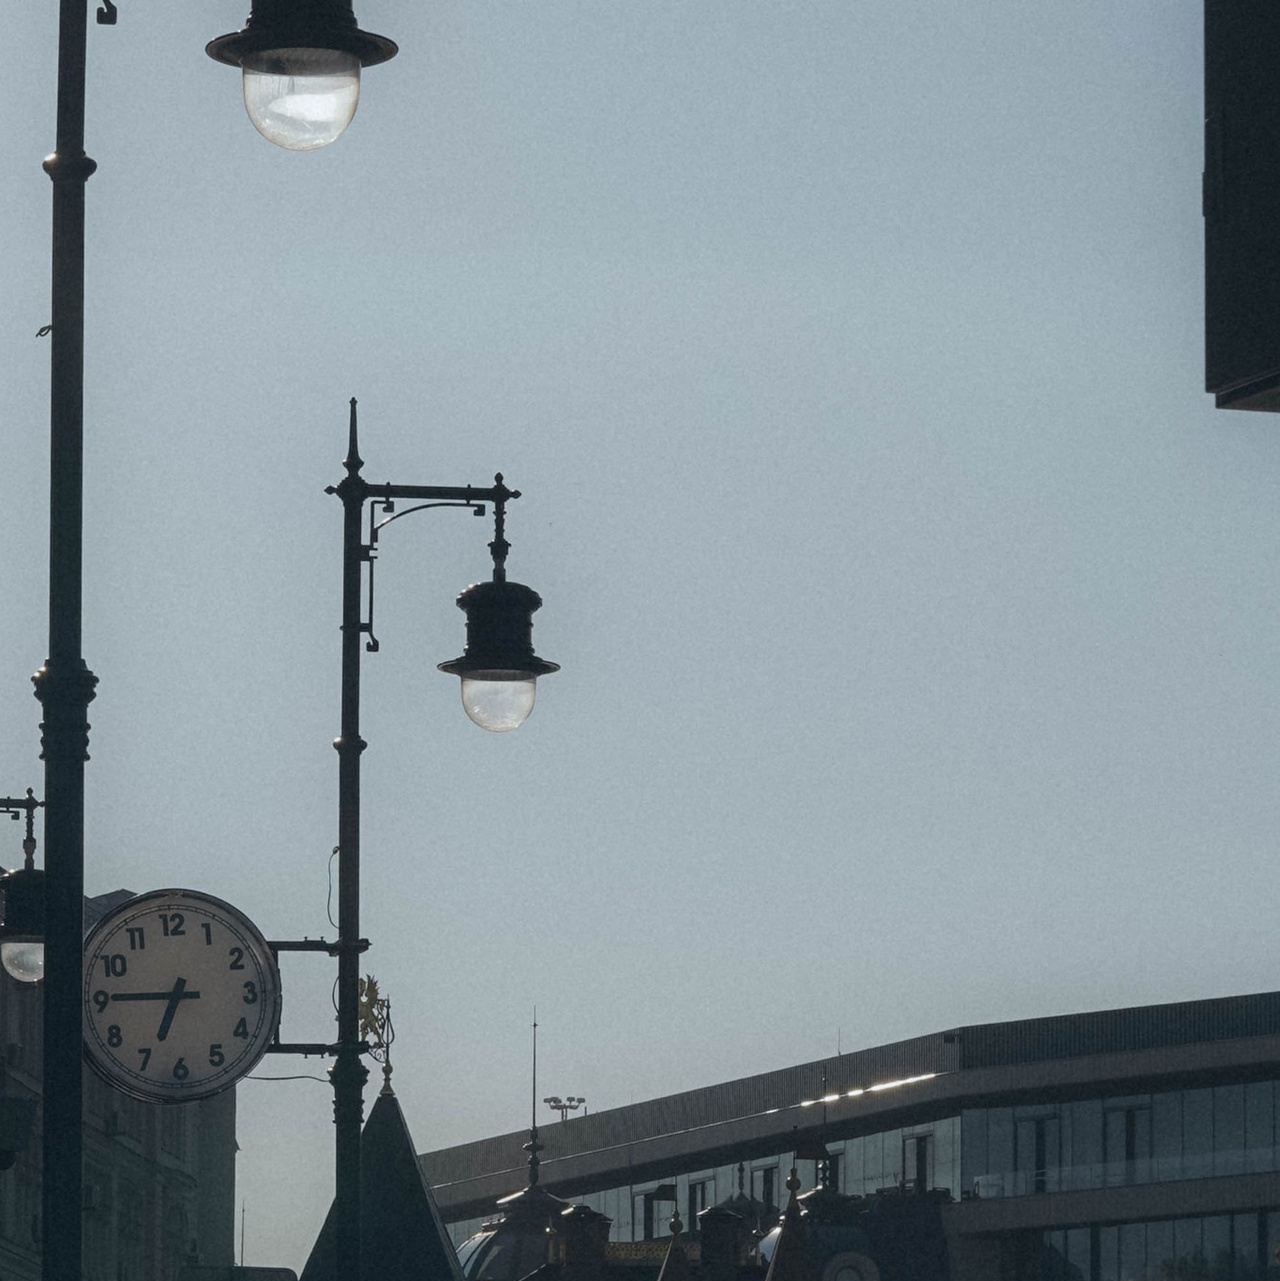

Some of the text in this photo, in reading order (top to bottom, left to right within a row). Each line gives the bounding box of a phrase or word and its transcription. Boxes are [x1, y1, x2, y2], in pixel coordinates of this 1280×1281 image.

[158, 913, 185, 936] 12
[201, 923, 212, 945] 1
[126, 927, 145, 950] 11
[100, 954, 127, 977] 10
[229, 948, 244, 970] 2
[93, 990, 109, 1013] 9
[243, 981, 257, 1004] 3
[107, 1025, 122, 1048] 8
[233, 1018, 248, 1040] 4
[138, 1048, 151, 1071] 7
[209, 1044, 224, 1067] 5
[173, 1058, 189, 1080] 6
